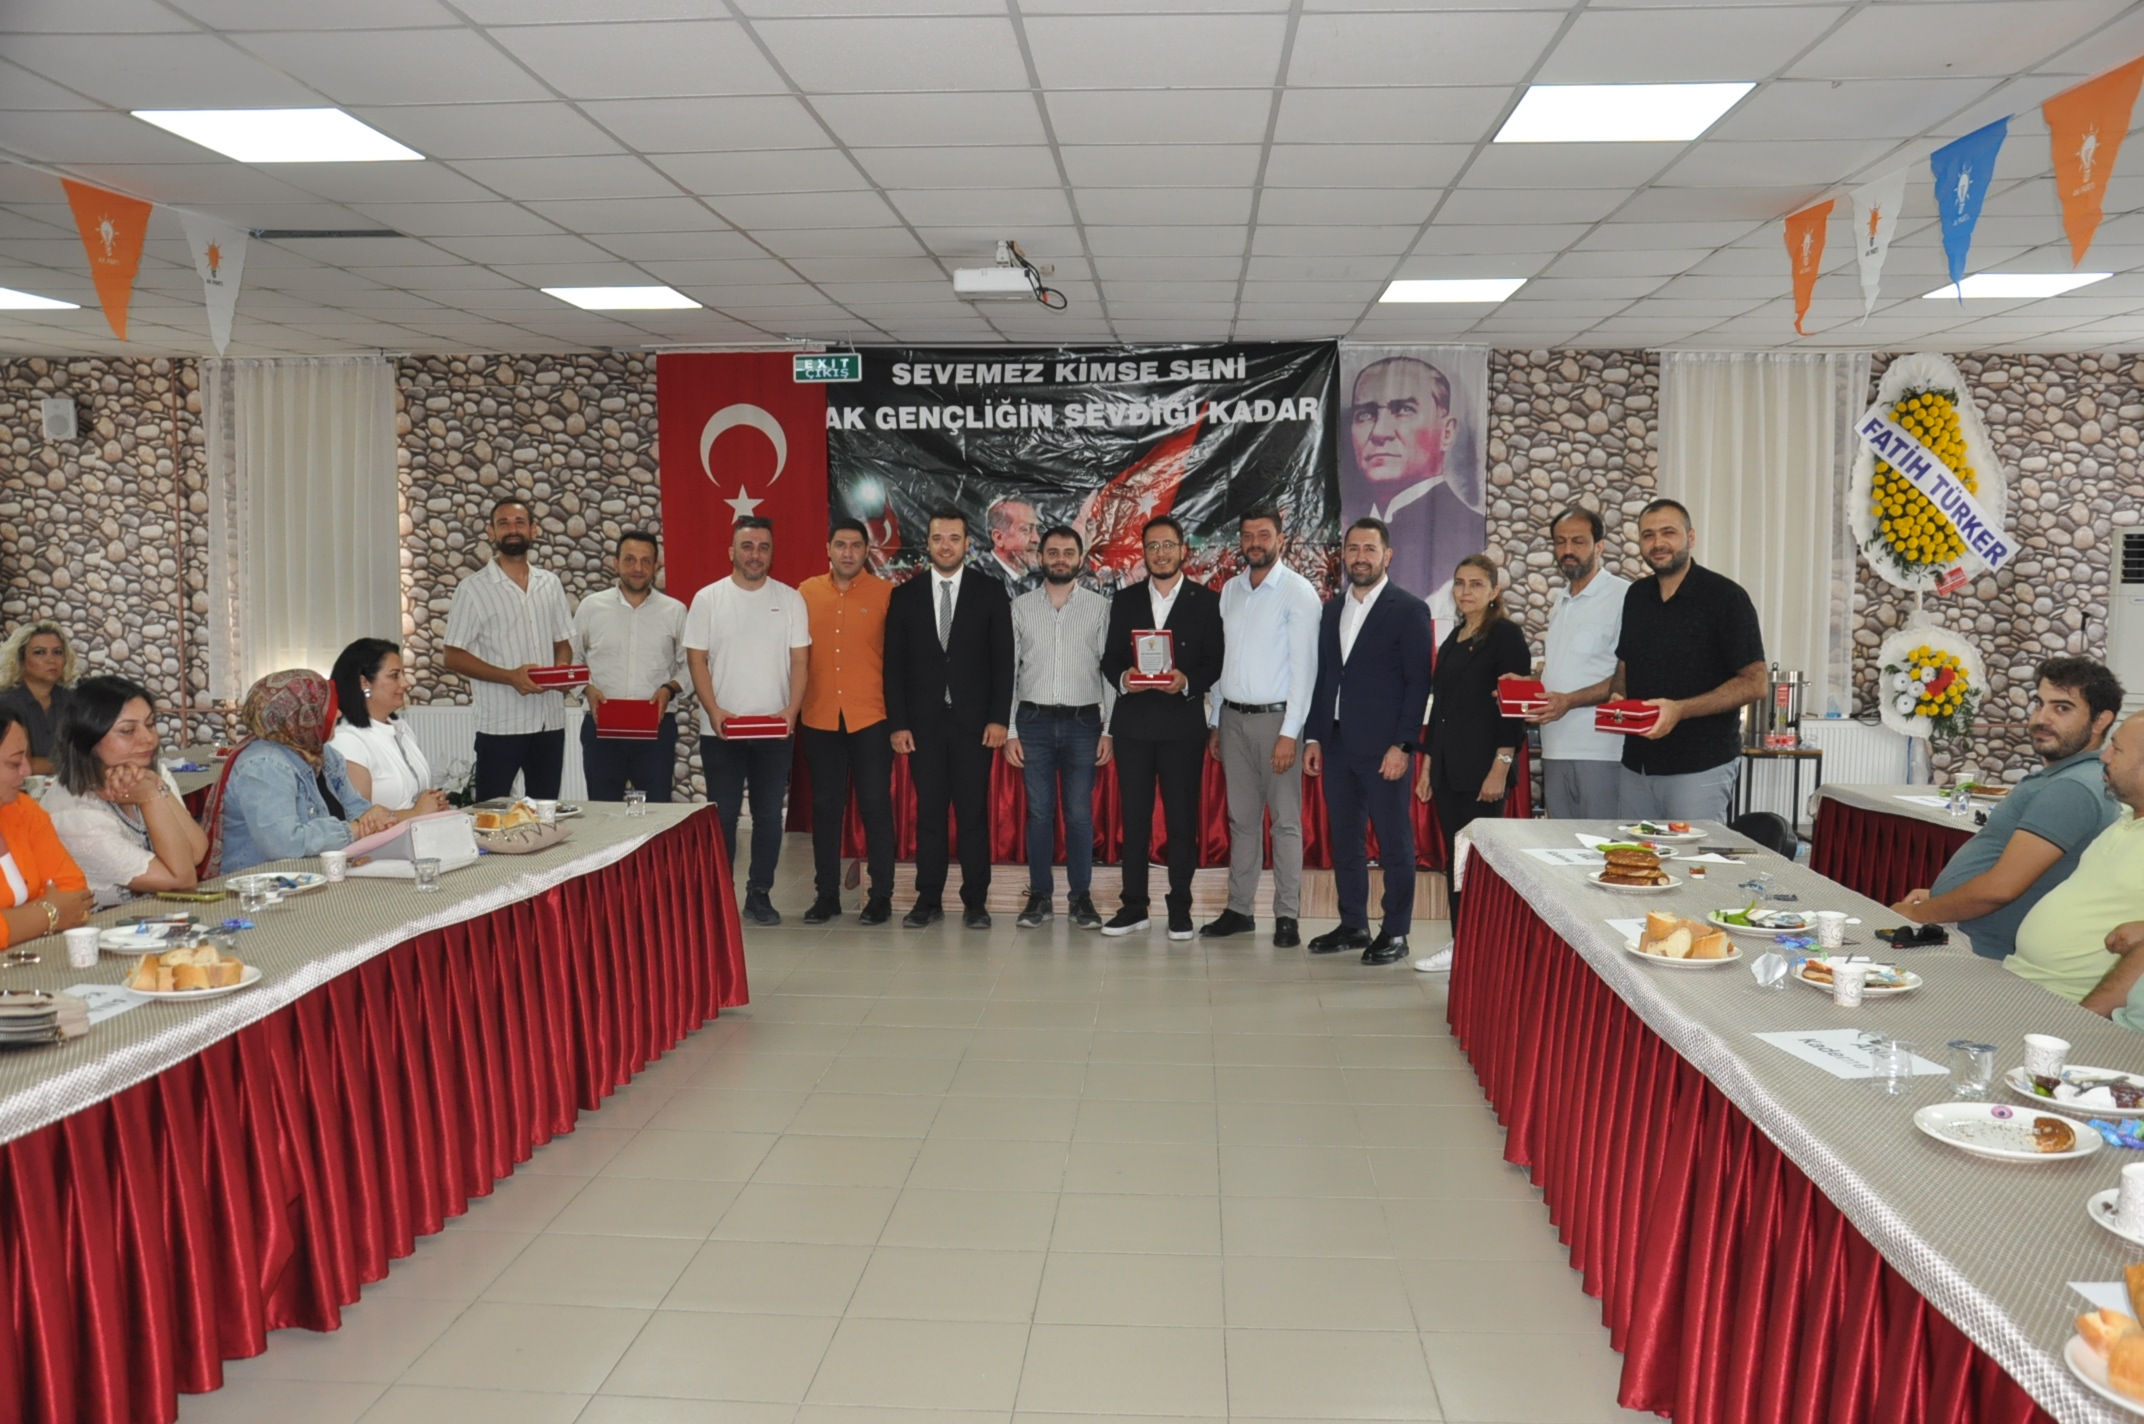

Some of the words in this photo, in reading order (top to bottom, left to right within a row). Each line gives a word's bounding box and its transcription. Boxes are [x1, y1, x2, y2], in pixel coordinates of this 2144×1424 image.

[804, 358, 850, 369] EXIT
[805, 368, 850, 380] ÇIKIŞ
[892, 363, 1044, 386] SEVEMEZ
[1055, 357, 1159, 382] KİMSE
[1170, 353, 1246, 380] SENİ
[826, 406, 865, 430] AK
[875, 398, 1052, 436] GENÇLİĞİN
[1208, 397, 1320, 424] KADAR
[1862, 417, 1932, 482] FATİH
[1929, 473, 2008, 567] TÜRKER
